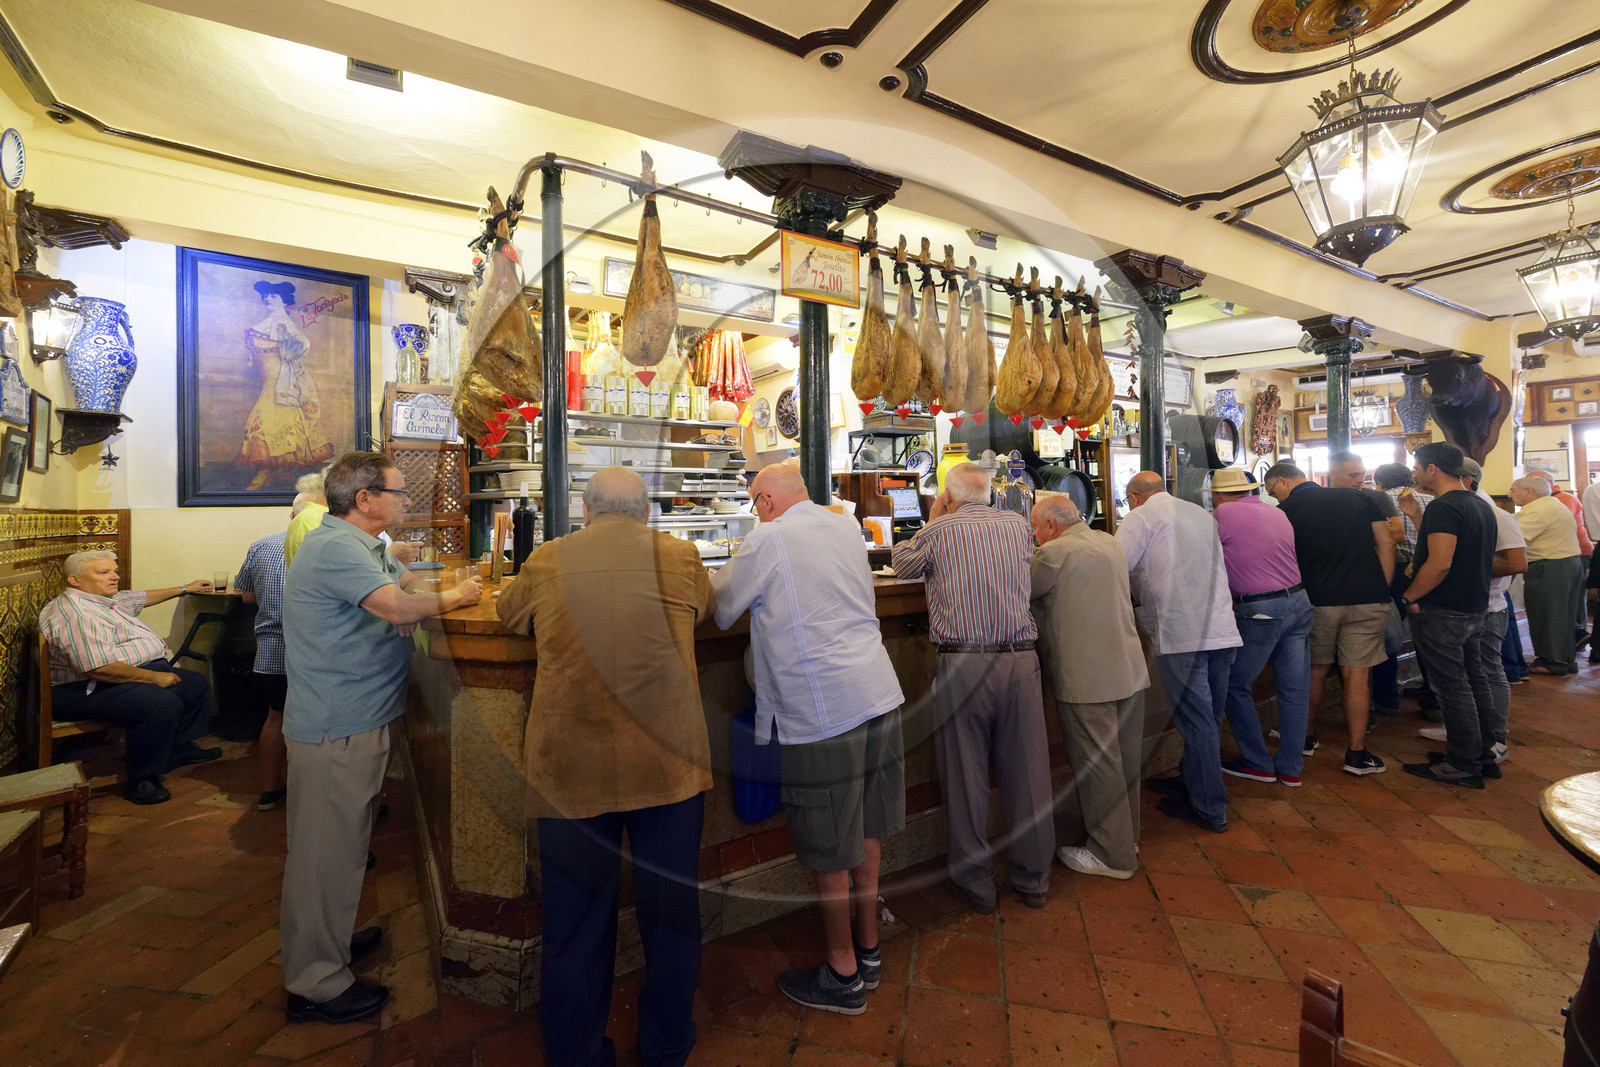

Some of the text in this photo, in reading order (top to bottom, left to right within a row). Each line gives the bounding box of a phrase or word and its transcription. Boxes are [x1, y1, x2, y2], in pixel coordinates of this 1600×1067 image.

[811, 269, 843, 294] 72,00
[402, 407, 451, 424] El Rincón
[406, 420, 445, 435] Carmelo
